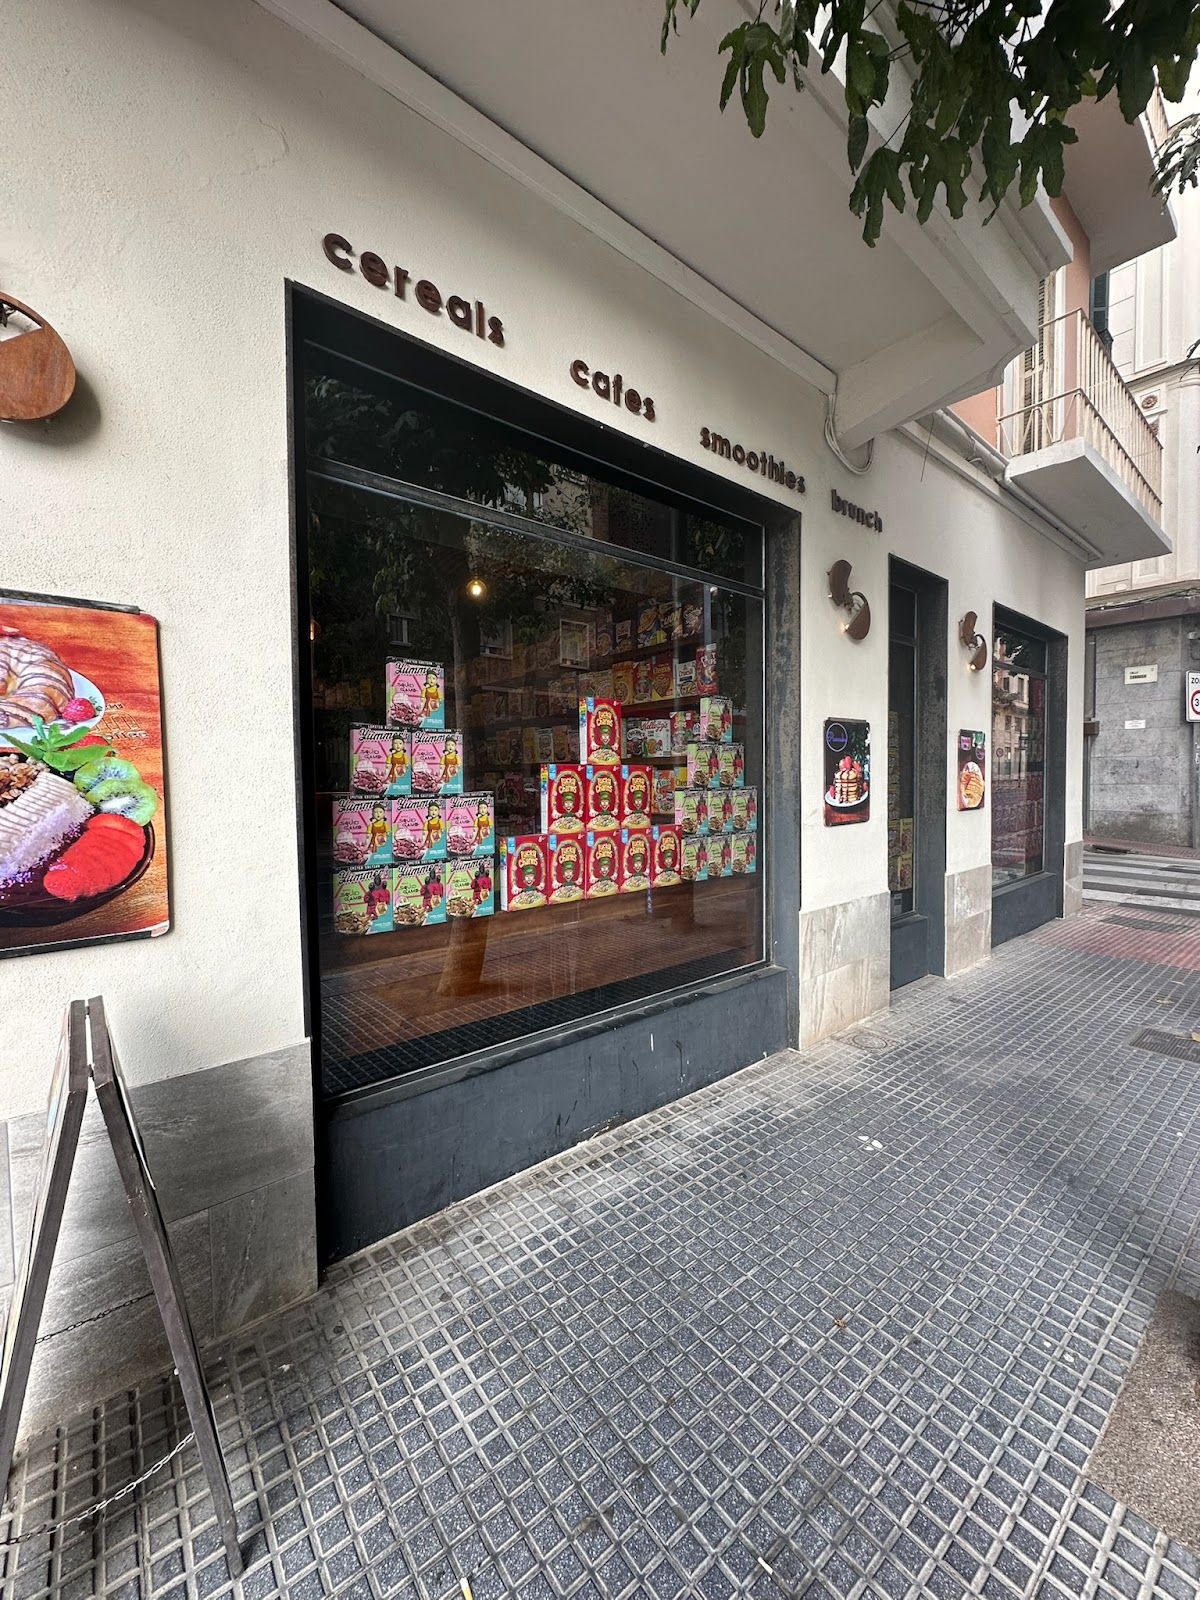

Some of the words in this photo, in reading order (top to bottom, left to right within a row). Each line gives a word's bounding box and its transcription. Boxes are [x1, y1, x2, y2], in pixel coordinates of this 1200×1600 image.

[323, 233, 506, 347] cereals
[570, 358, 656, 421] cafes
[700, 426, 806, 494] smoothies
[831, 489, 883, 532] brunch
